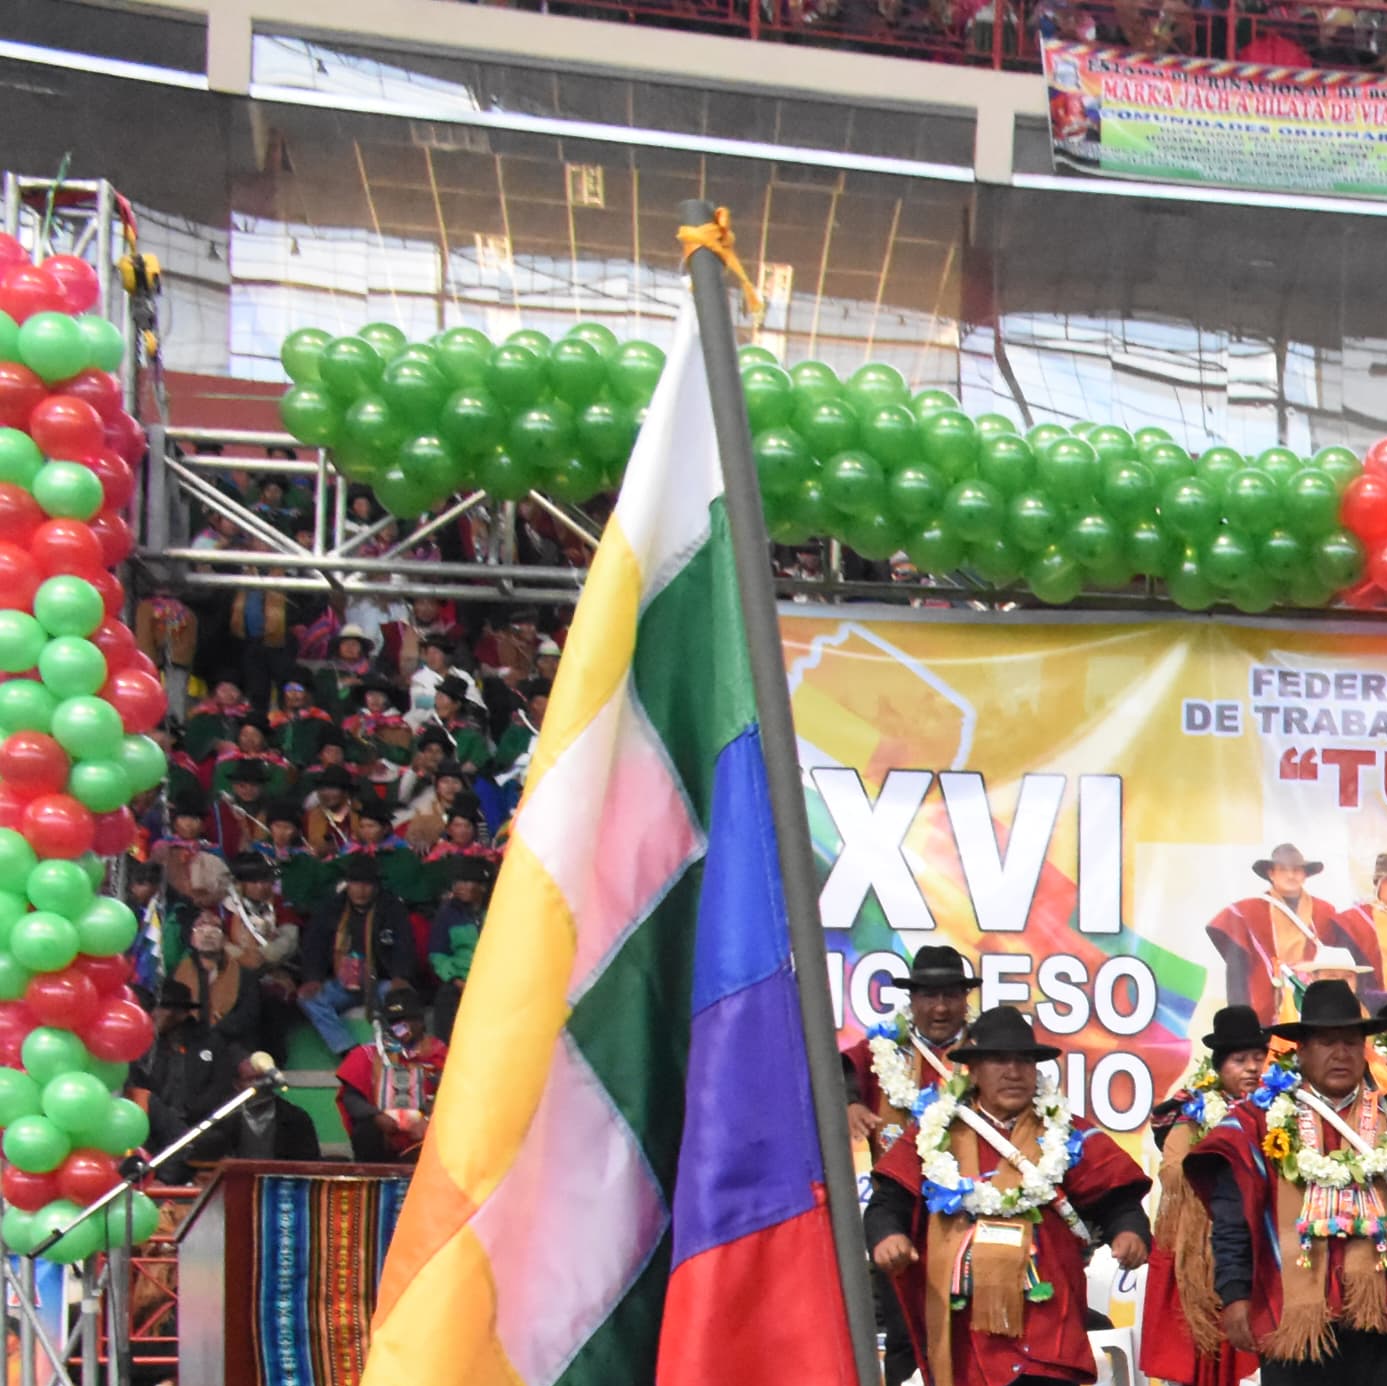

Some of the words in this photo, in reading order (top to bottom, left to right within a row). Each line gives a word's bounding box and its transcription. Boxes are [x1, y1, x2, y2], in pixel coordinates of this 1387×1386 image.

[1088, 58, 1164, 77] ESTADO
[1171, 70, 1327, 97] PLURINACIONAL
[1338, 85, 1359, 98] DE
[1103, 78, 1175, 107] MARKA
[1331, 103, 1354, 123] DE
[1101, 108, 1270, 134] COMUNIDADES
[1185, 702, 1239, 733] DE
[810, 766, 1122, 933] XVI
